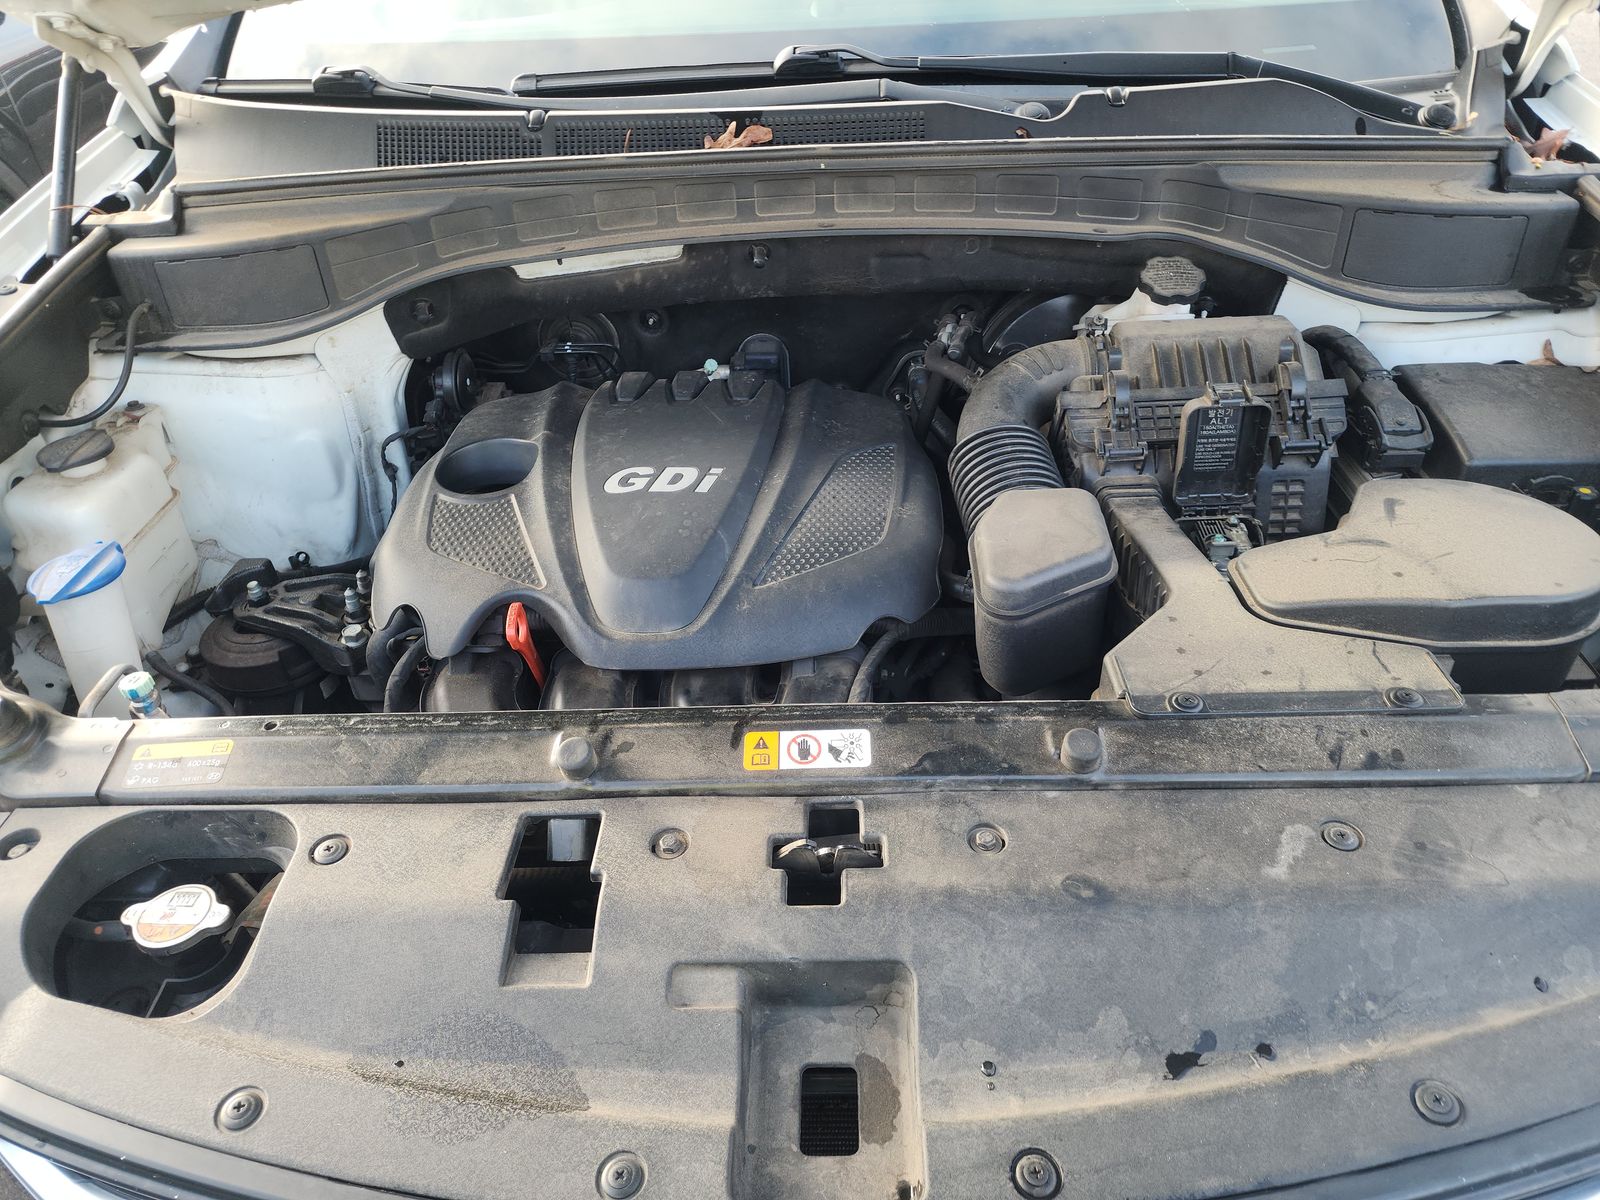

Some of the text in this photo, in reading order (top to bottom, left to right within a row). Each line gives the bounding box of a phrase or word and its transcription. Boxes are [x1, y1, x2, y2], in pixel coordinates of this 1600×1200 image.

[1208, 408, 1234, 417] 발전기
[1209, 417, 1230, 425] ALT
[603, 466, 724, 494] GDi
